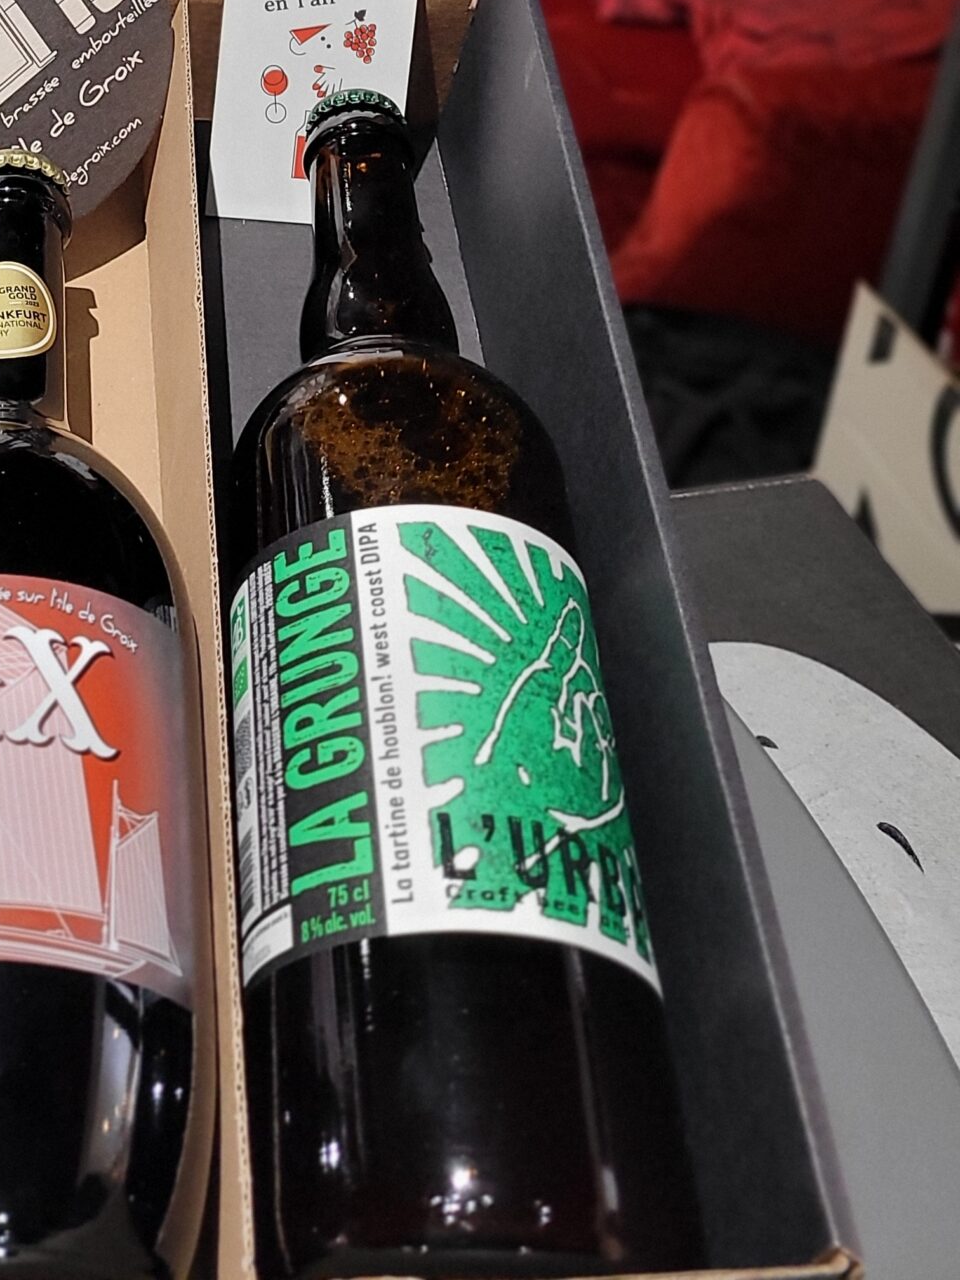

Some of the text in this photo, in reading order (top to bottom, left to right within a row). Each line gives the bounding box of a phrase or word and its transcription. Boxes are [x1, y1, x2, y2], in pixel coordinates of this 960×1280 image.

[0, 76, 60, 128] brassée
[50, 109, 76, 138] de
[79, 50, 145, 107] Groix
[8, 292, 37, 301] GOLD
[17, 588, 45, 604] sur
[78, 601, 96, 624] de
[100, 614, 138, 653] Groix
[274, 527, 378, 897] LA GRUNGE
[357, 522, 414, 904] La tartine de houblon! west coast DIPA
[327, 878, 370, 908] 75 cl
[349, 903, 376, 926] vol.
